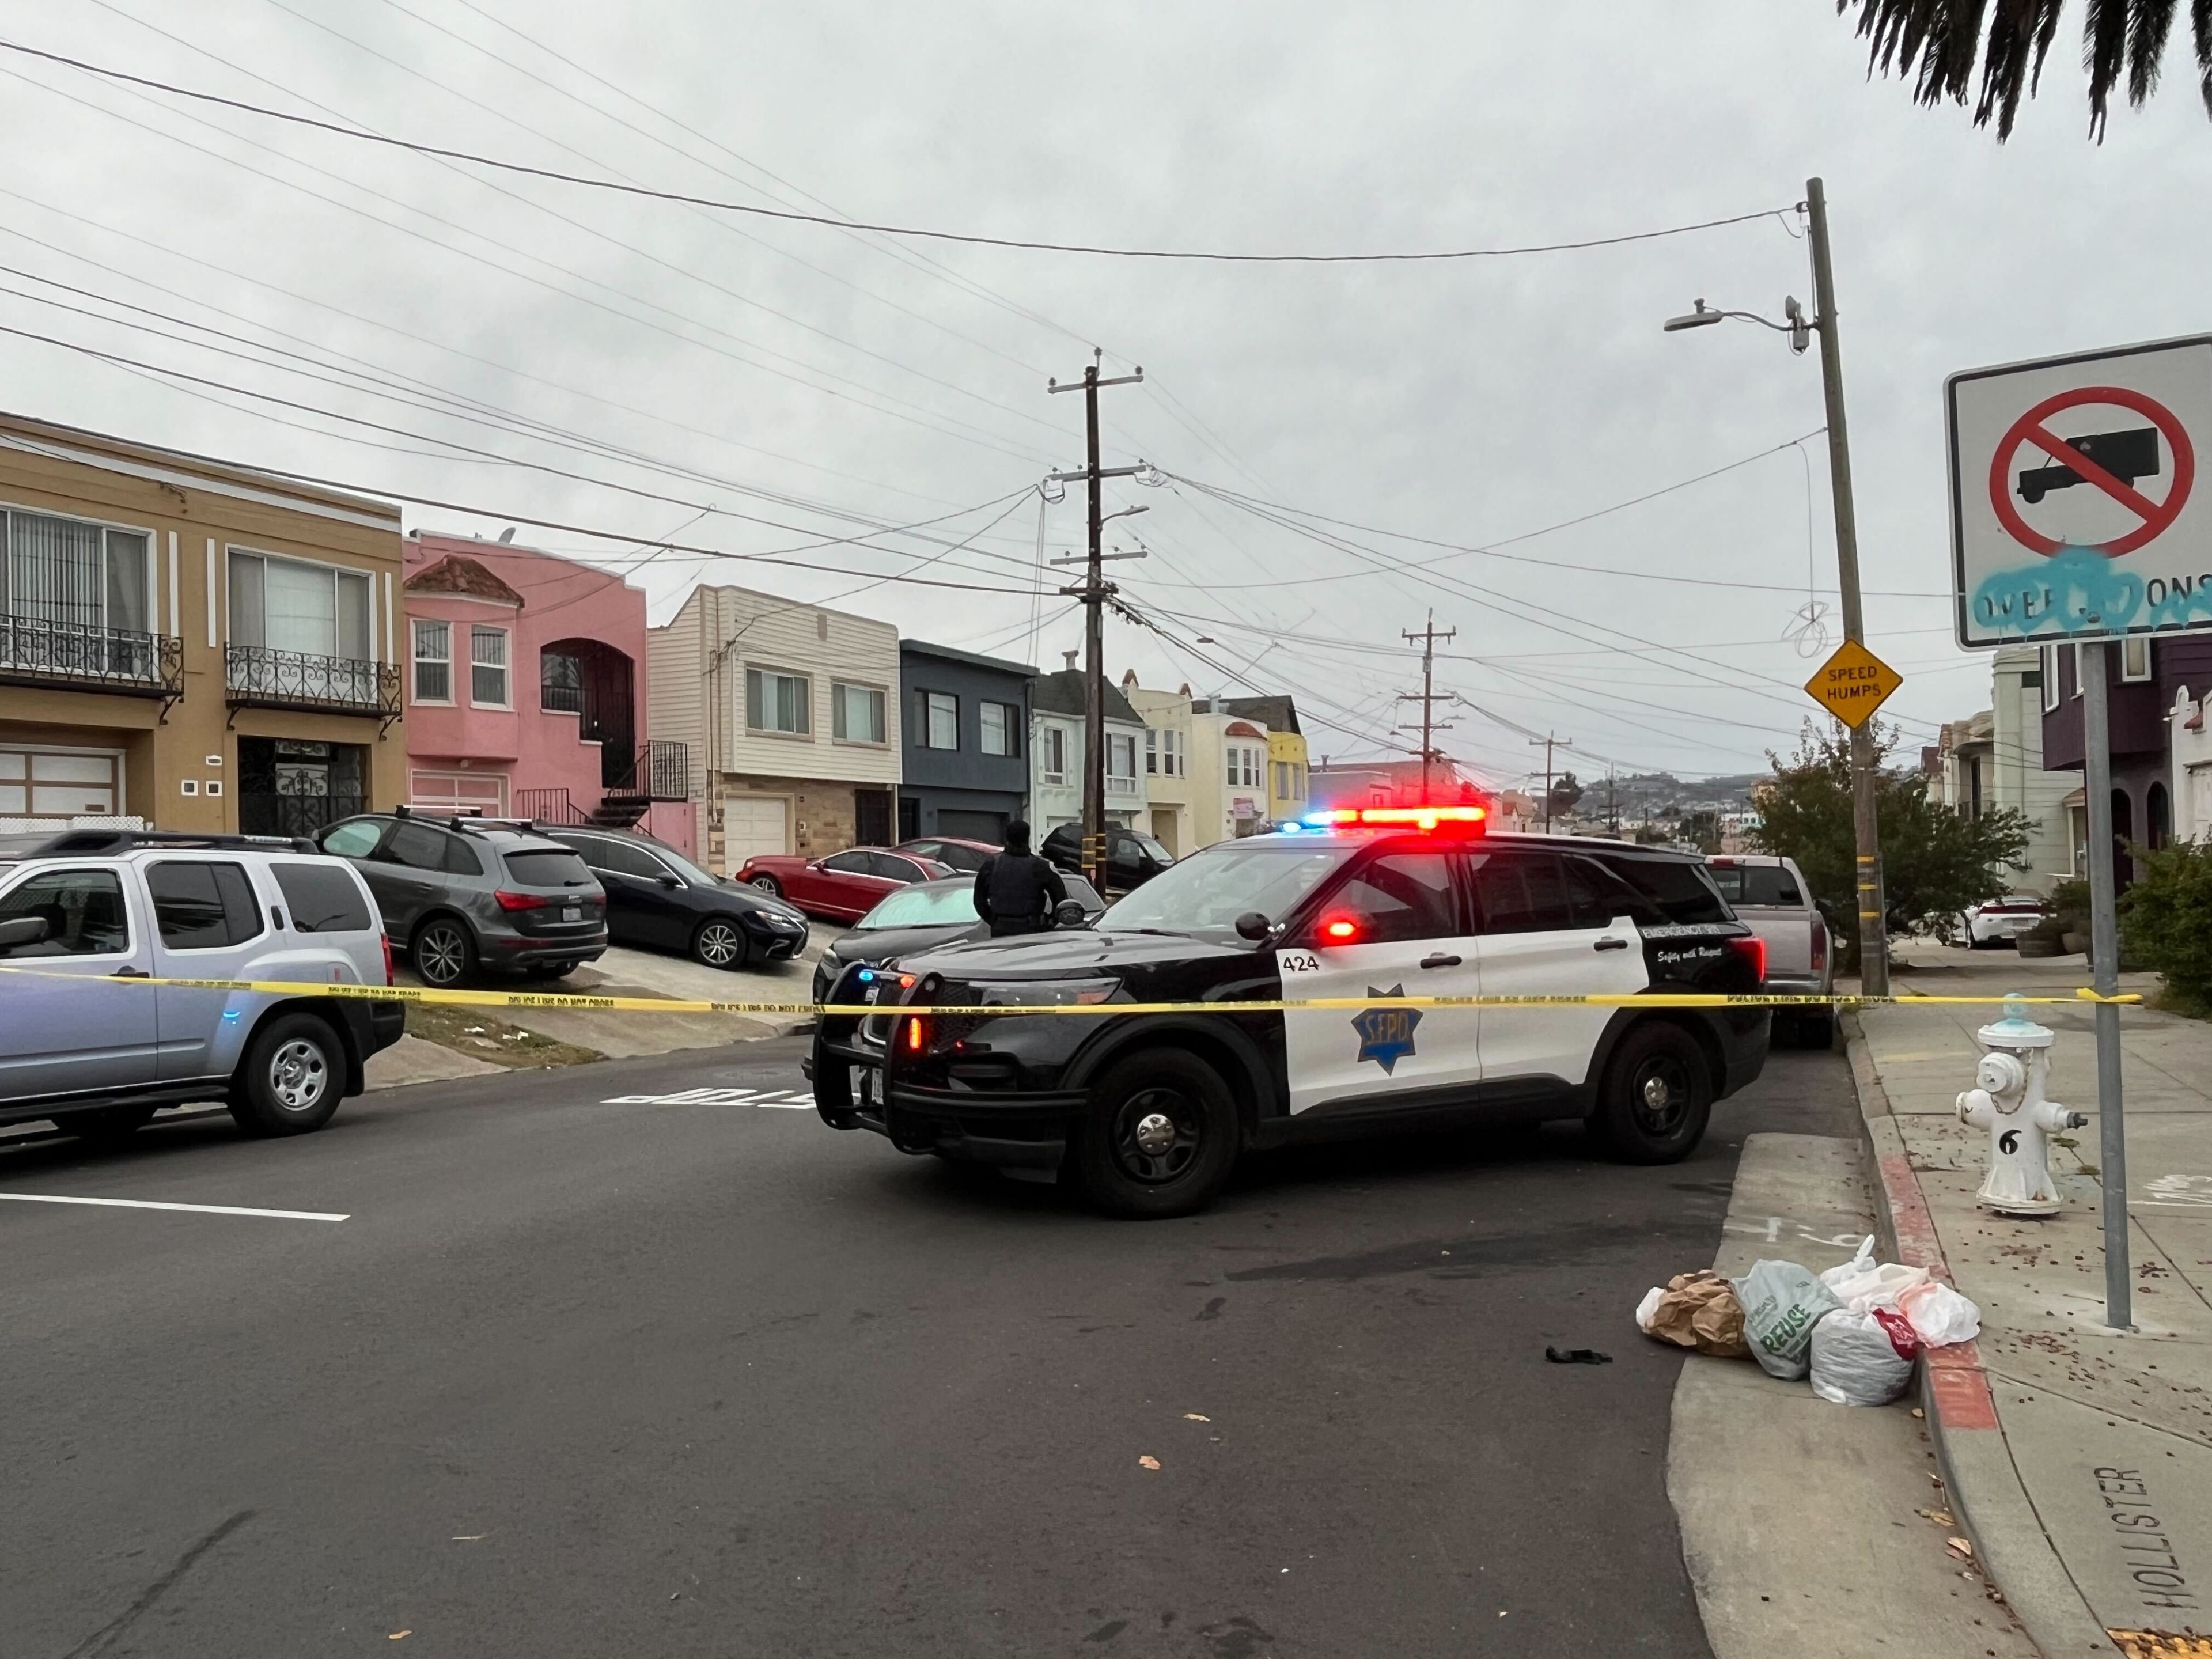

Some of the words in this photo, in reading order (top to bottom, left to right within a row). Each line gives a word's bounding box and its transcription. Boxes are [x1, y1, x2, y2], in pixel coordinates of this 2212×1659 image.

[1828, 666, 1877, 682] SPEED
[1827, 684, 1882, 700] HUMPS
[1283, 956, 1319, 972] 424
[1365, 1012, 1410, 1046] SFPD
[1999, 1129, 2022, 1155] 6
[1760, 1303, 1811, 1353] REUSE
[2094, 1467, 2199, 1609] HOLLISTER
